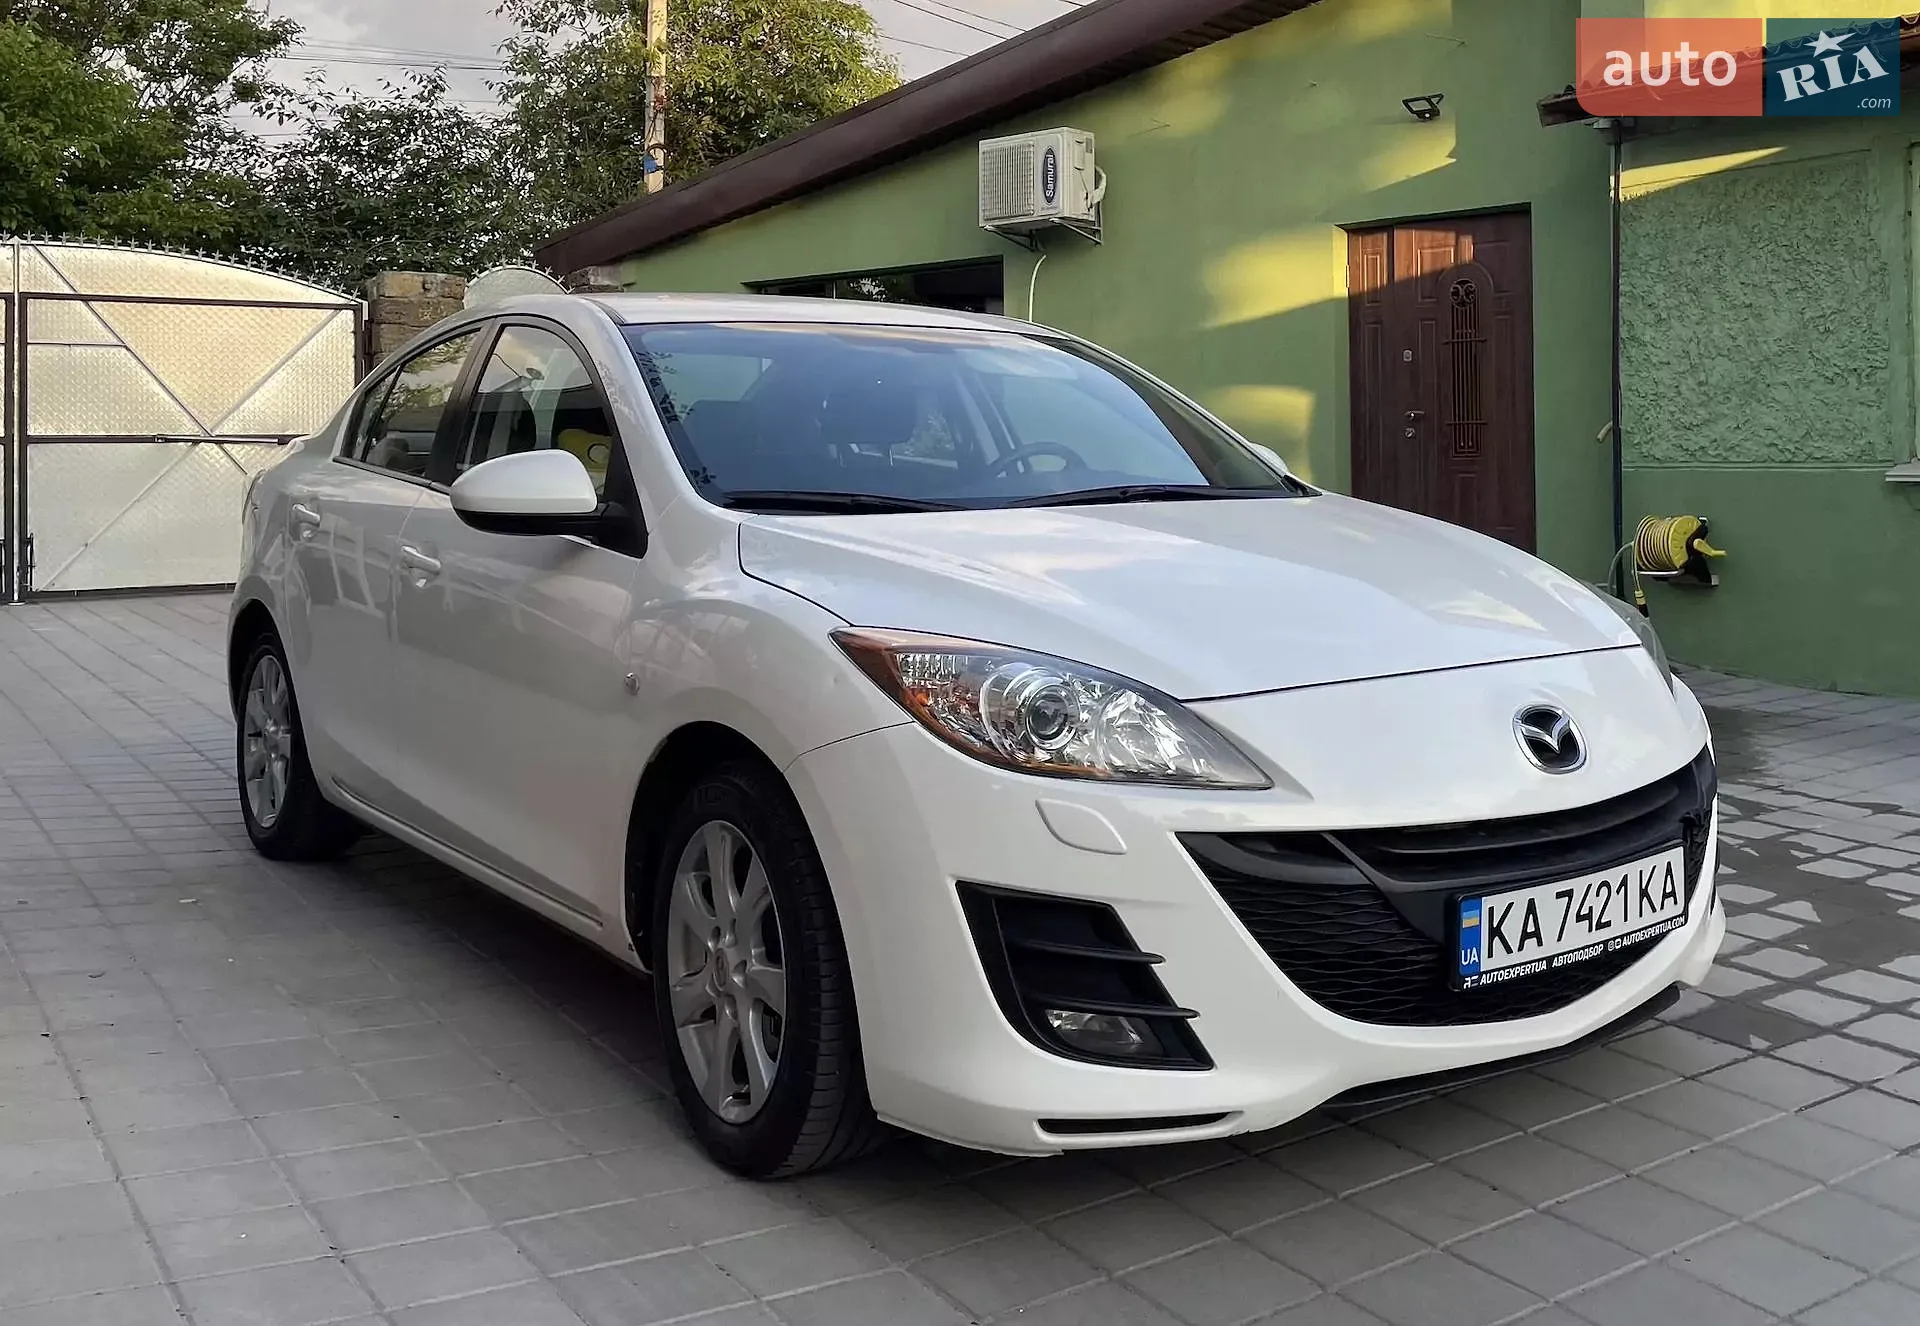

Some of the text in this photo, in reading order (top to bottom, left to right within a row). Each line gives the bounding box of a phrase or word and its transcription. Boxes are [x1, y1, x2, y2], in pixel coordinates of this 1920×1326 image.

[1487, 860, 1678, 959] KA 7421 KA
[1461, 947, 1479, 966] UA
[1480, 960, 1547, 986] AUTOEXPERTUA
